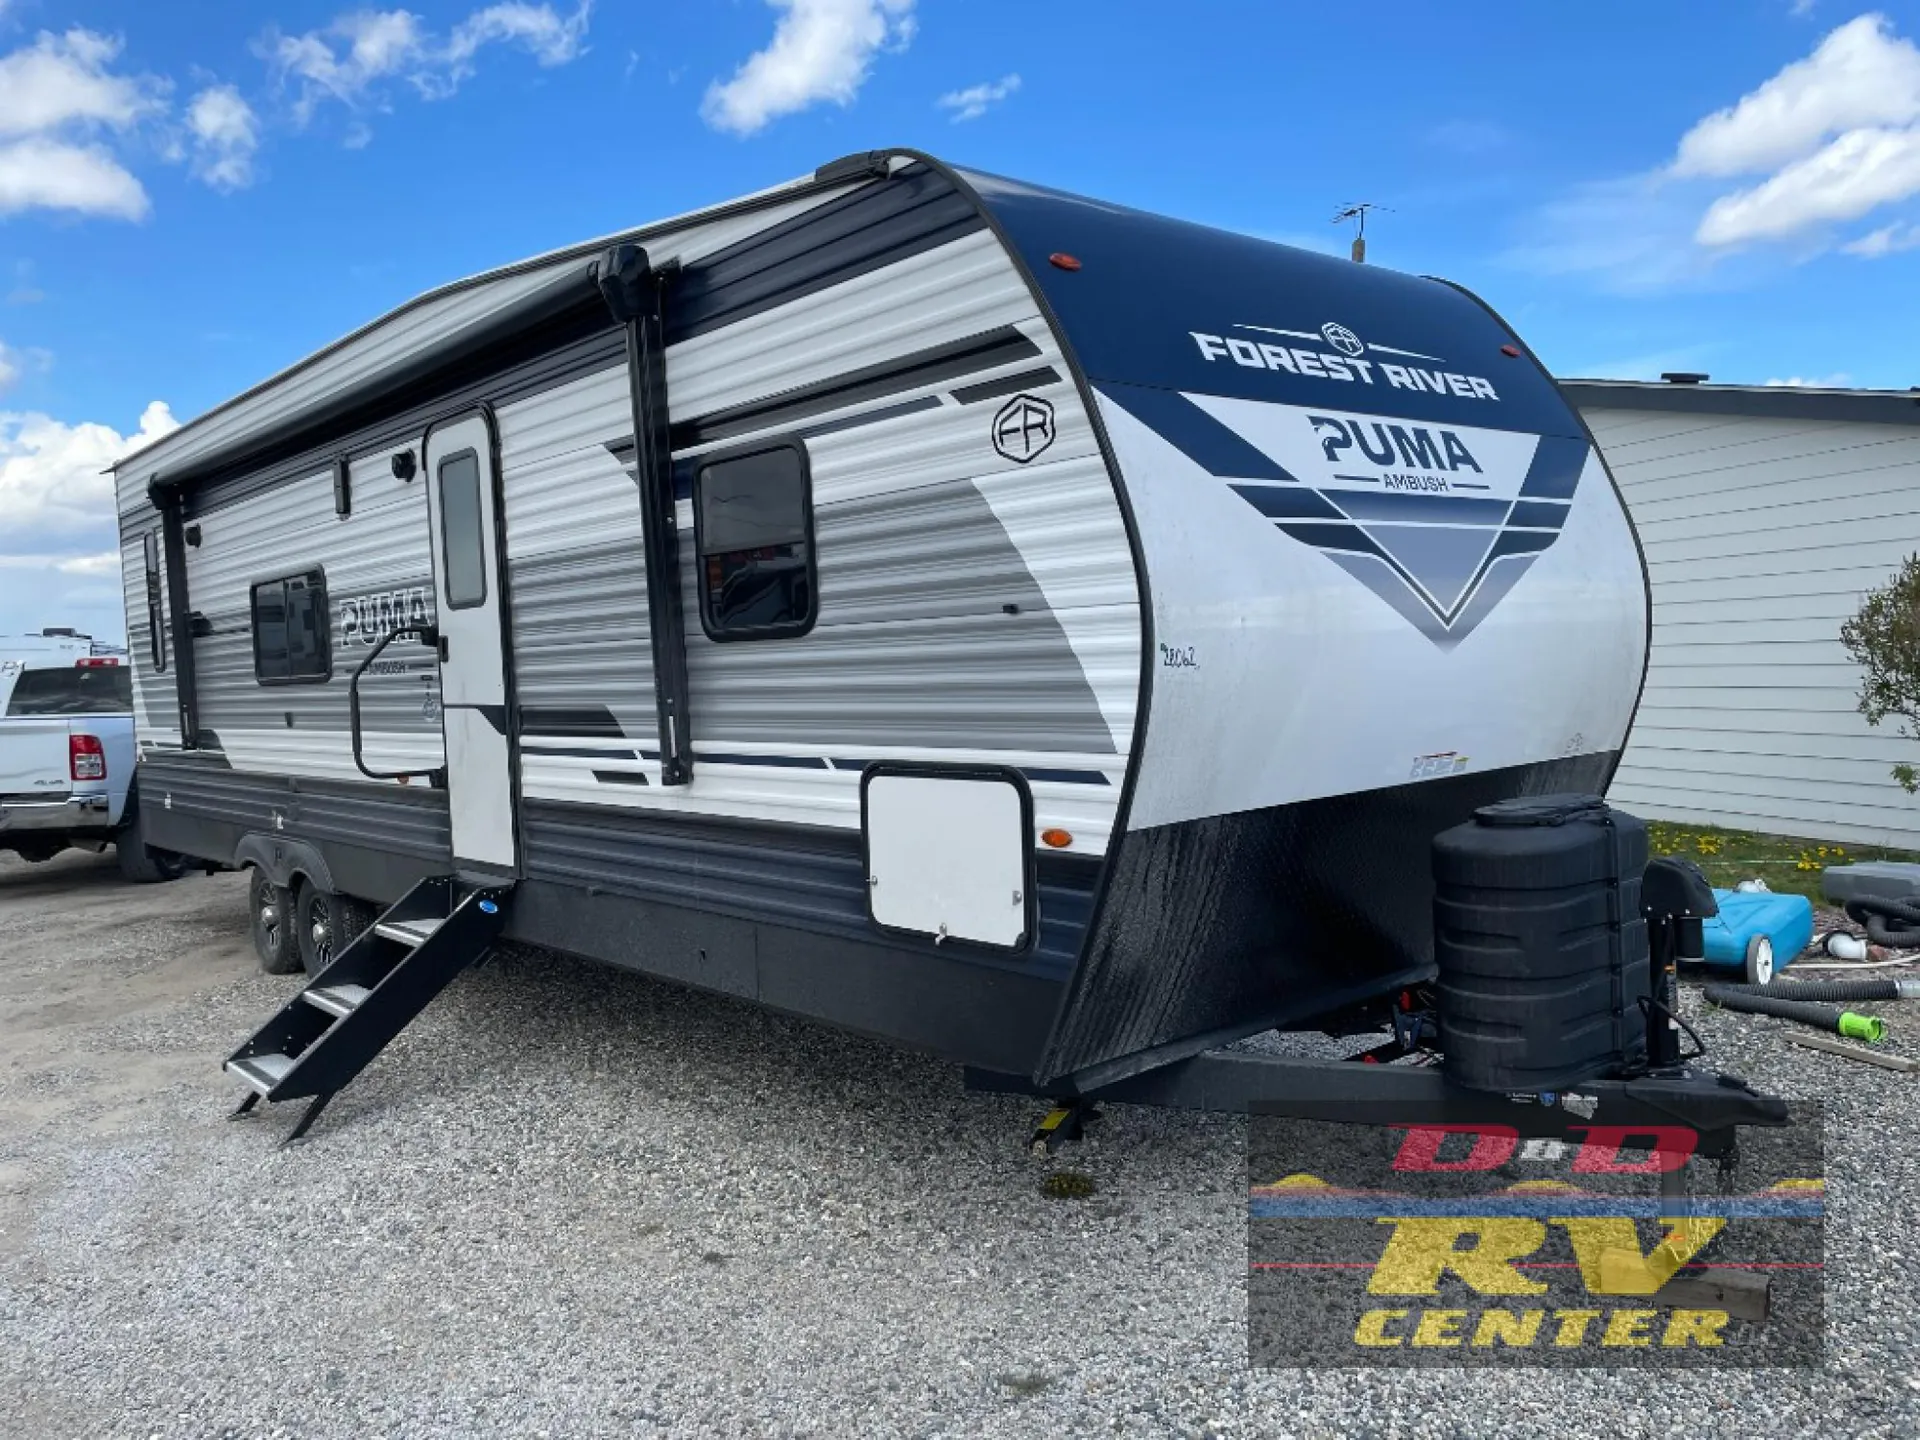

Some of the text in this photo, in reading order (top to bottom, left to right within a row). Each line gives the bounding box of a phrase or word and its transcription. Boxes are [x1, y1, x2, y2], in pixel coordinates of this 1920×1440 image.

[1188, 331, 1500, 401] FOREST RIVER
[1306, 415, 1484, 473] PUMA
[1383, 473, 1450, 492] AMBUSH
[339, 586, 433, 648] PUMA
